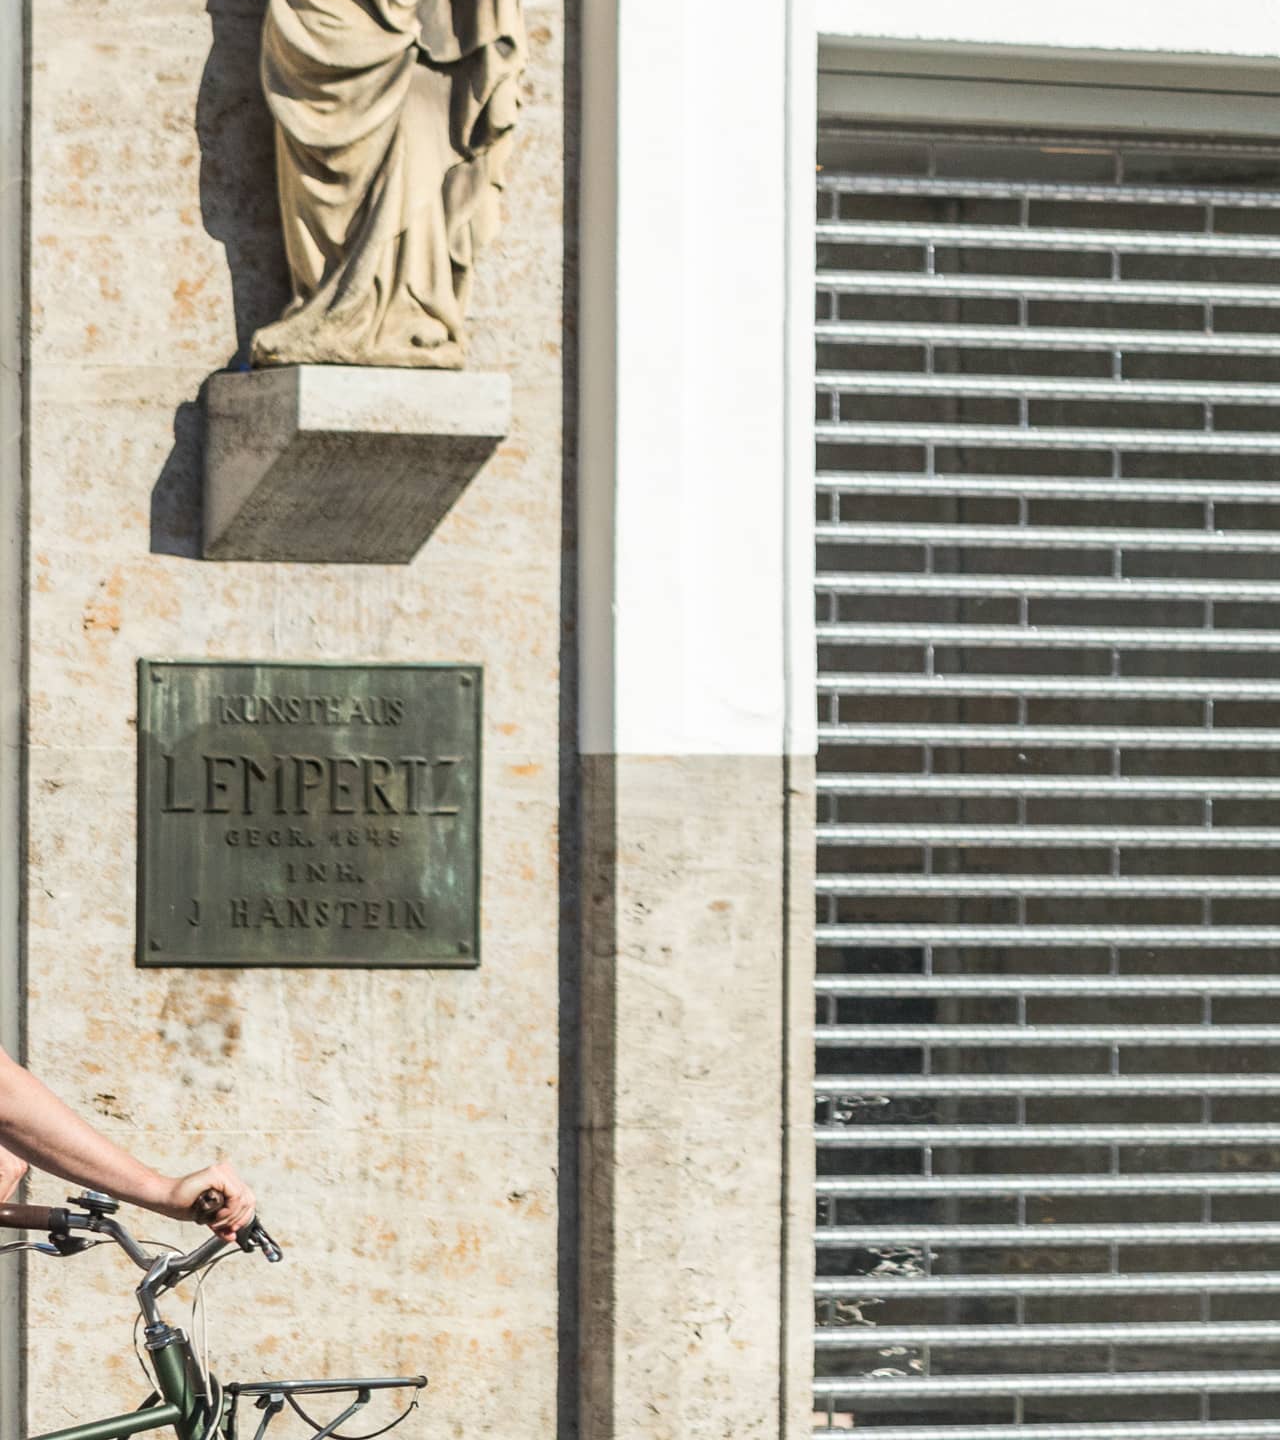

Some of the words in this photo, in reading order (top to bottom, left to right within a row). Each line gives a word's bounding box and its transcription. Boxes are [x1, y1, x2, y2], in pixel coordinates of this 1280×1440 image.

[217, 694, 405, 727] KUNSTHAUS
[160, 753, 461, 817] LEMPERTZ
[229, 897, 428, 930] HANSTEIN
